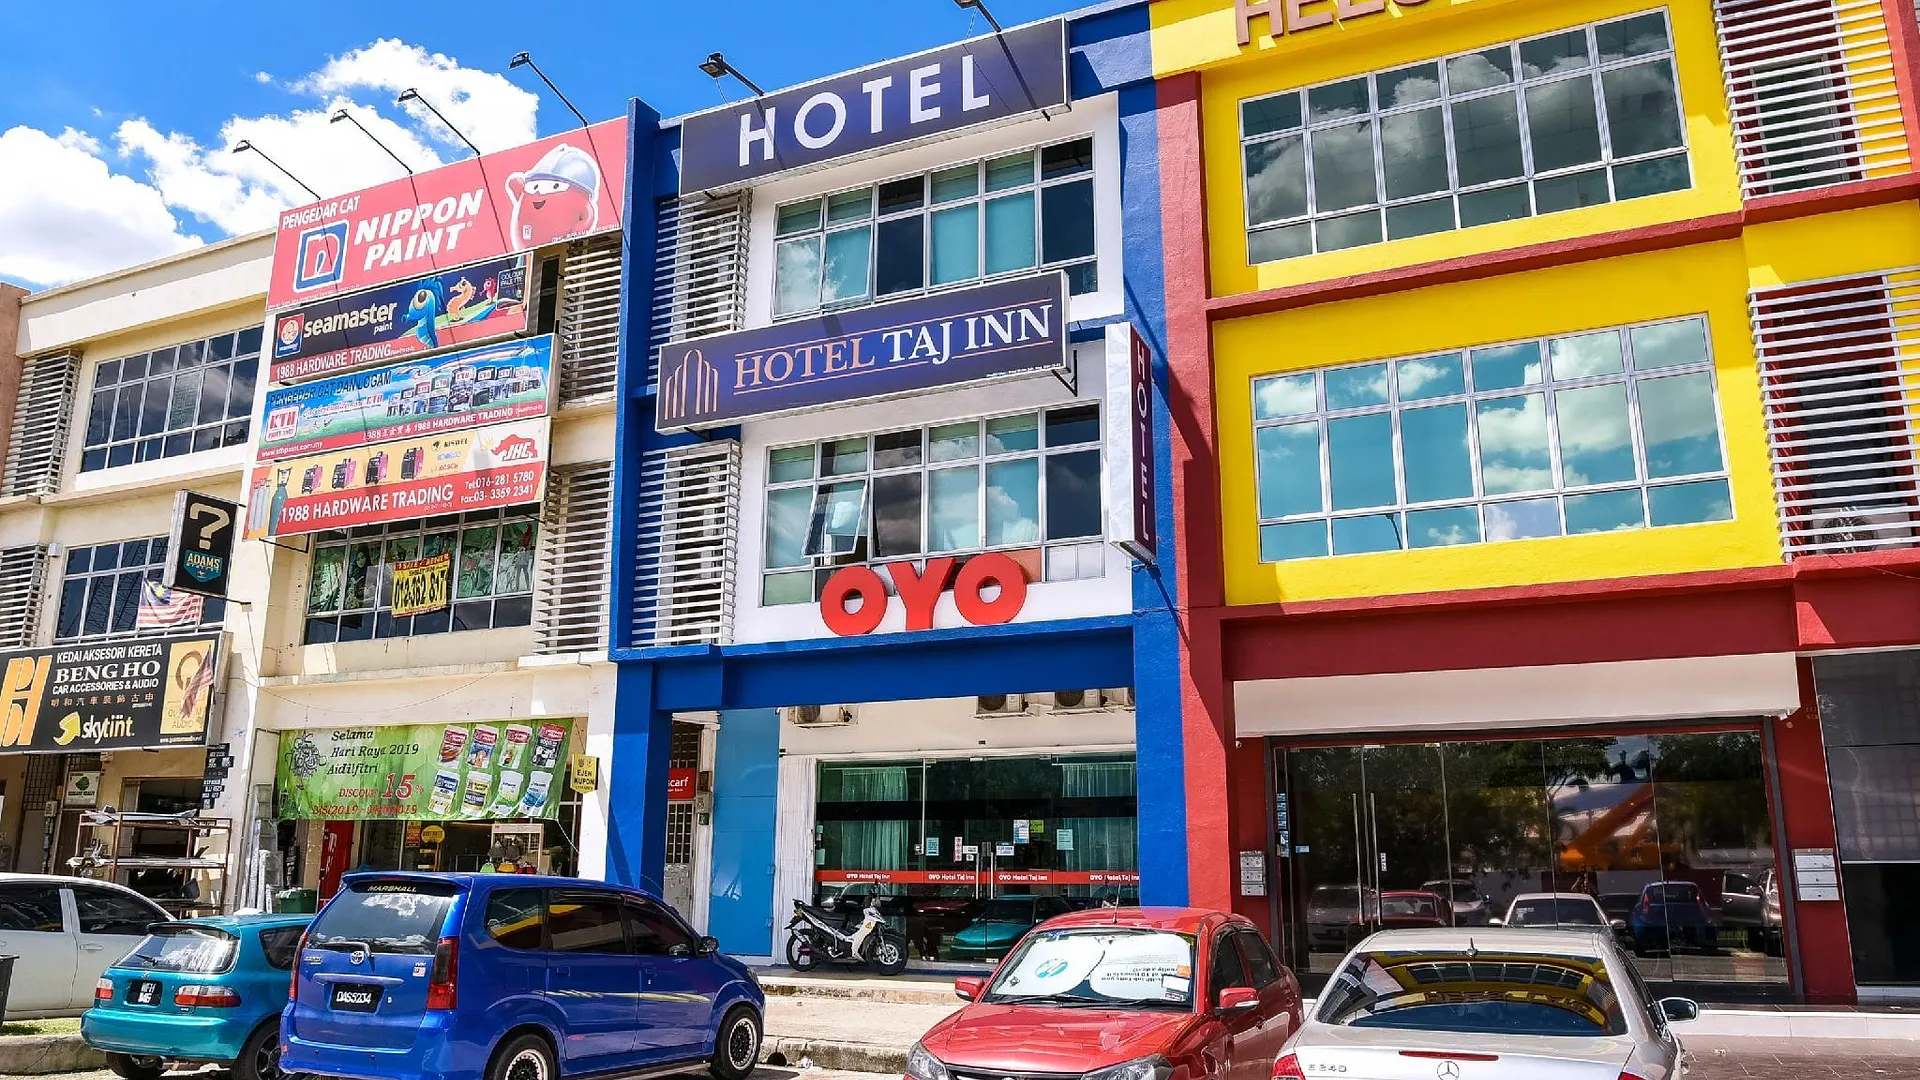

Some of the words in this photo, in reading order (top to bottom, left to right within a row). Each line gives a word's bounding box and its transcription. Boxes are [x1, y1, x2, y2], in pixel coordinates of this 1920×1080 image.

[739, 55, 990, 167] HOTEL
[282, 202, 338, 230] PENGEDAR
[340, 196, 360, 215] CAT
[353, 188, 485, 245] NIPPON
[363, 223, 465, 271] PAINT
[303, 301, 397, 338] seamaster
[373, 321, 393, 337] paint
[734, 338, 875, 390] HOTEL
[883, 321, 955, 365] TAJ
[964, 304, 1052, 350] INN
[276, 361, 295, 379] 1988
[296, 352, 347, 375] HARDWARE
[350, 344, 391, 365] TRADING
[270, 388, 315, 407] PENGEDAR
[269, 411, 297, 429] KTH
[432, 414, 476, 429] HARDWARE
[477, 408, 513, 421] TRADING
[1136, 339, 1149, 541] HOTEL
[502, 442, 532, 461] JHC
[512, 469, 534, 484] 5780
[490, 486, 511, 499] 3359
[513, 483, 534, 497] 2341
[281, 502, 309, 524] 1988
[312, 493, 388, 519] HARDWARE
[392, 484, 453, 509] TRADING
[187, 552, 221, 569] ADAMS
[820, 552, 1027, 636] OYO
[56, 650, 82, 664] KEDAI
[83, 647, 127, 662] AKSESORI
[128, 643, 163, 658] KERETA
[54, 662, 120, 684] BENG
[121, 660, 161, 678] HO
[52, 684, 70, 695] CAR
[70, 681, 124, 693] ACCESSORIES
[132, 678, 159, 689] AUDIO
[330, 746, 356, 759] Hari
[358, 745, 387, 759] Raya
[389, 744, 419, 755] 2019
[574, 778, 595, 786] KUPON
[577, 769, 592, 777] EJEN
[381, 773, 415, 800] 15
[367, 885, 417, 893] MARSHALL
